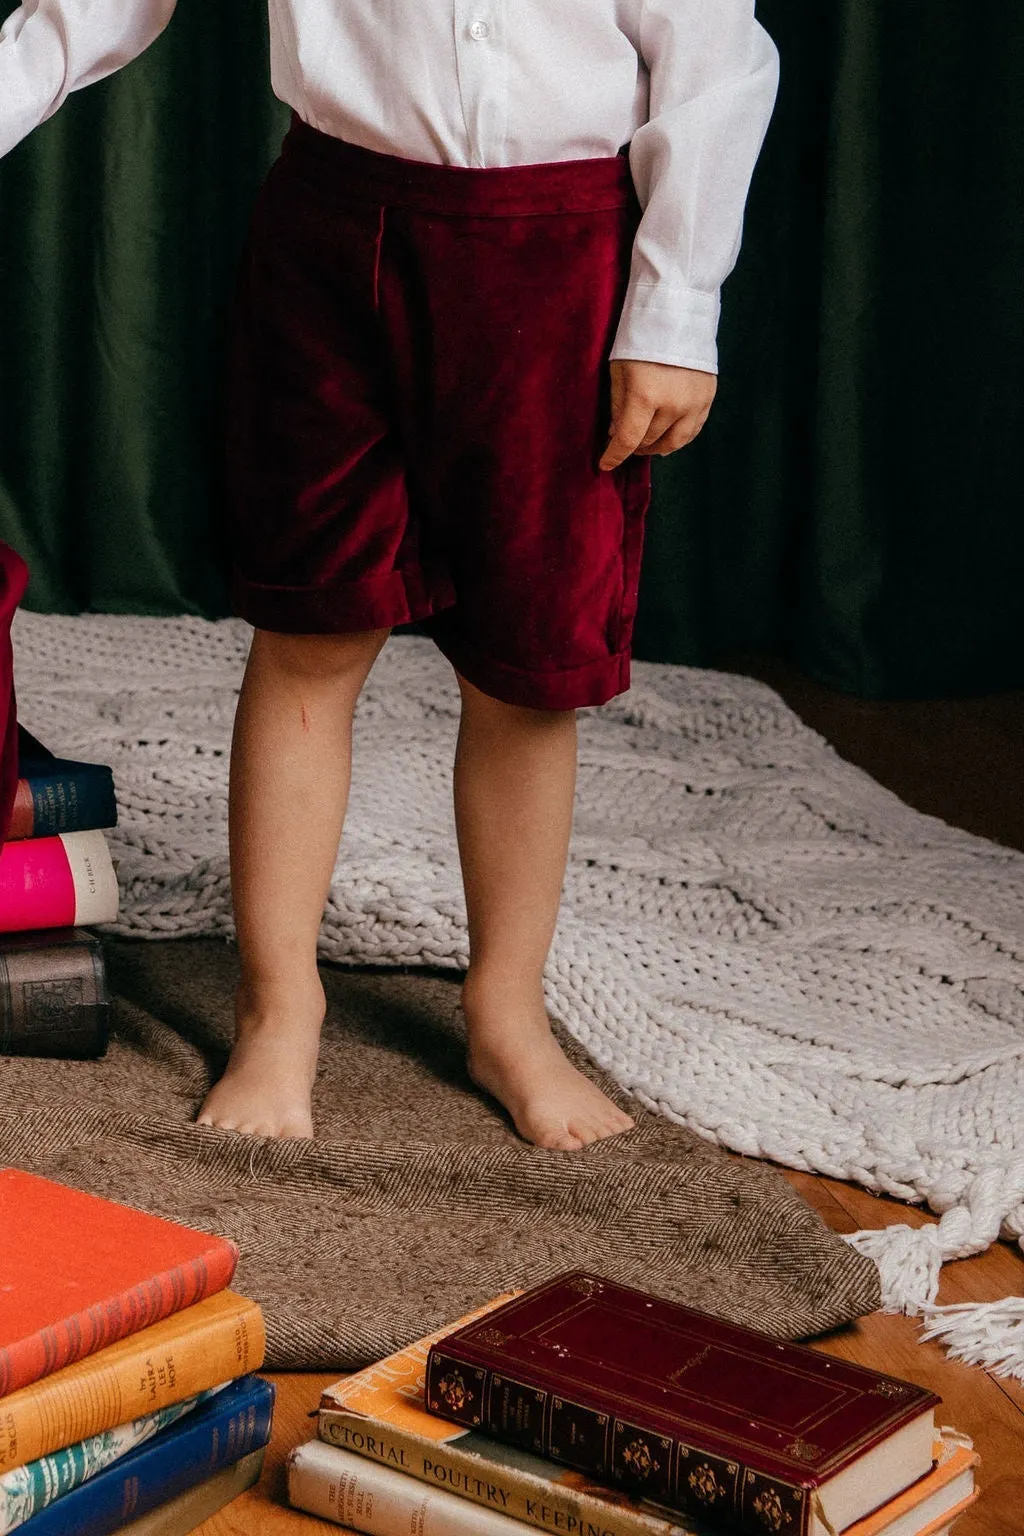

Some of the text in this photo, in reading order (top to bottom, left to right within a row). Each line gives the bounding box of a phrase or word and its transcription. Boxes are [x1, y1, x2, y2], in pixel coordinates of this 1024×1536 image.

[140, 1377, 147, 1391] by
[146, 1358, 157, 1402] LAURA
[157, 1366, 167, 1386] LEE
[166, 1356, 176, 1388] HOPE
[7, 1413, 18, 1459] CIRCUS
[423, 1459, 511, 1507] POULTRY
[356, 1490, 364, 1516] ROLL
